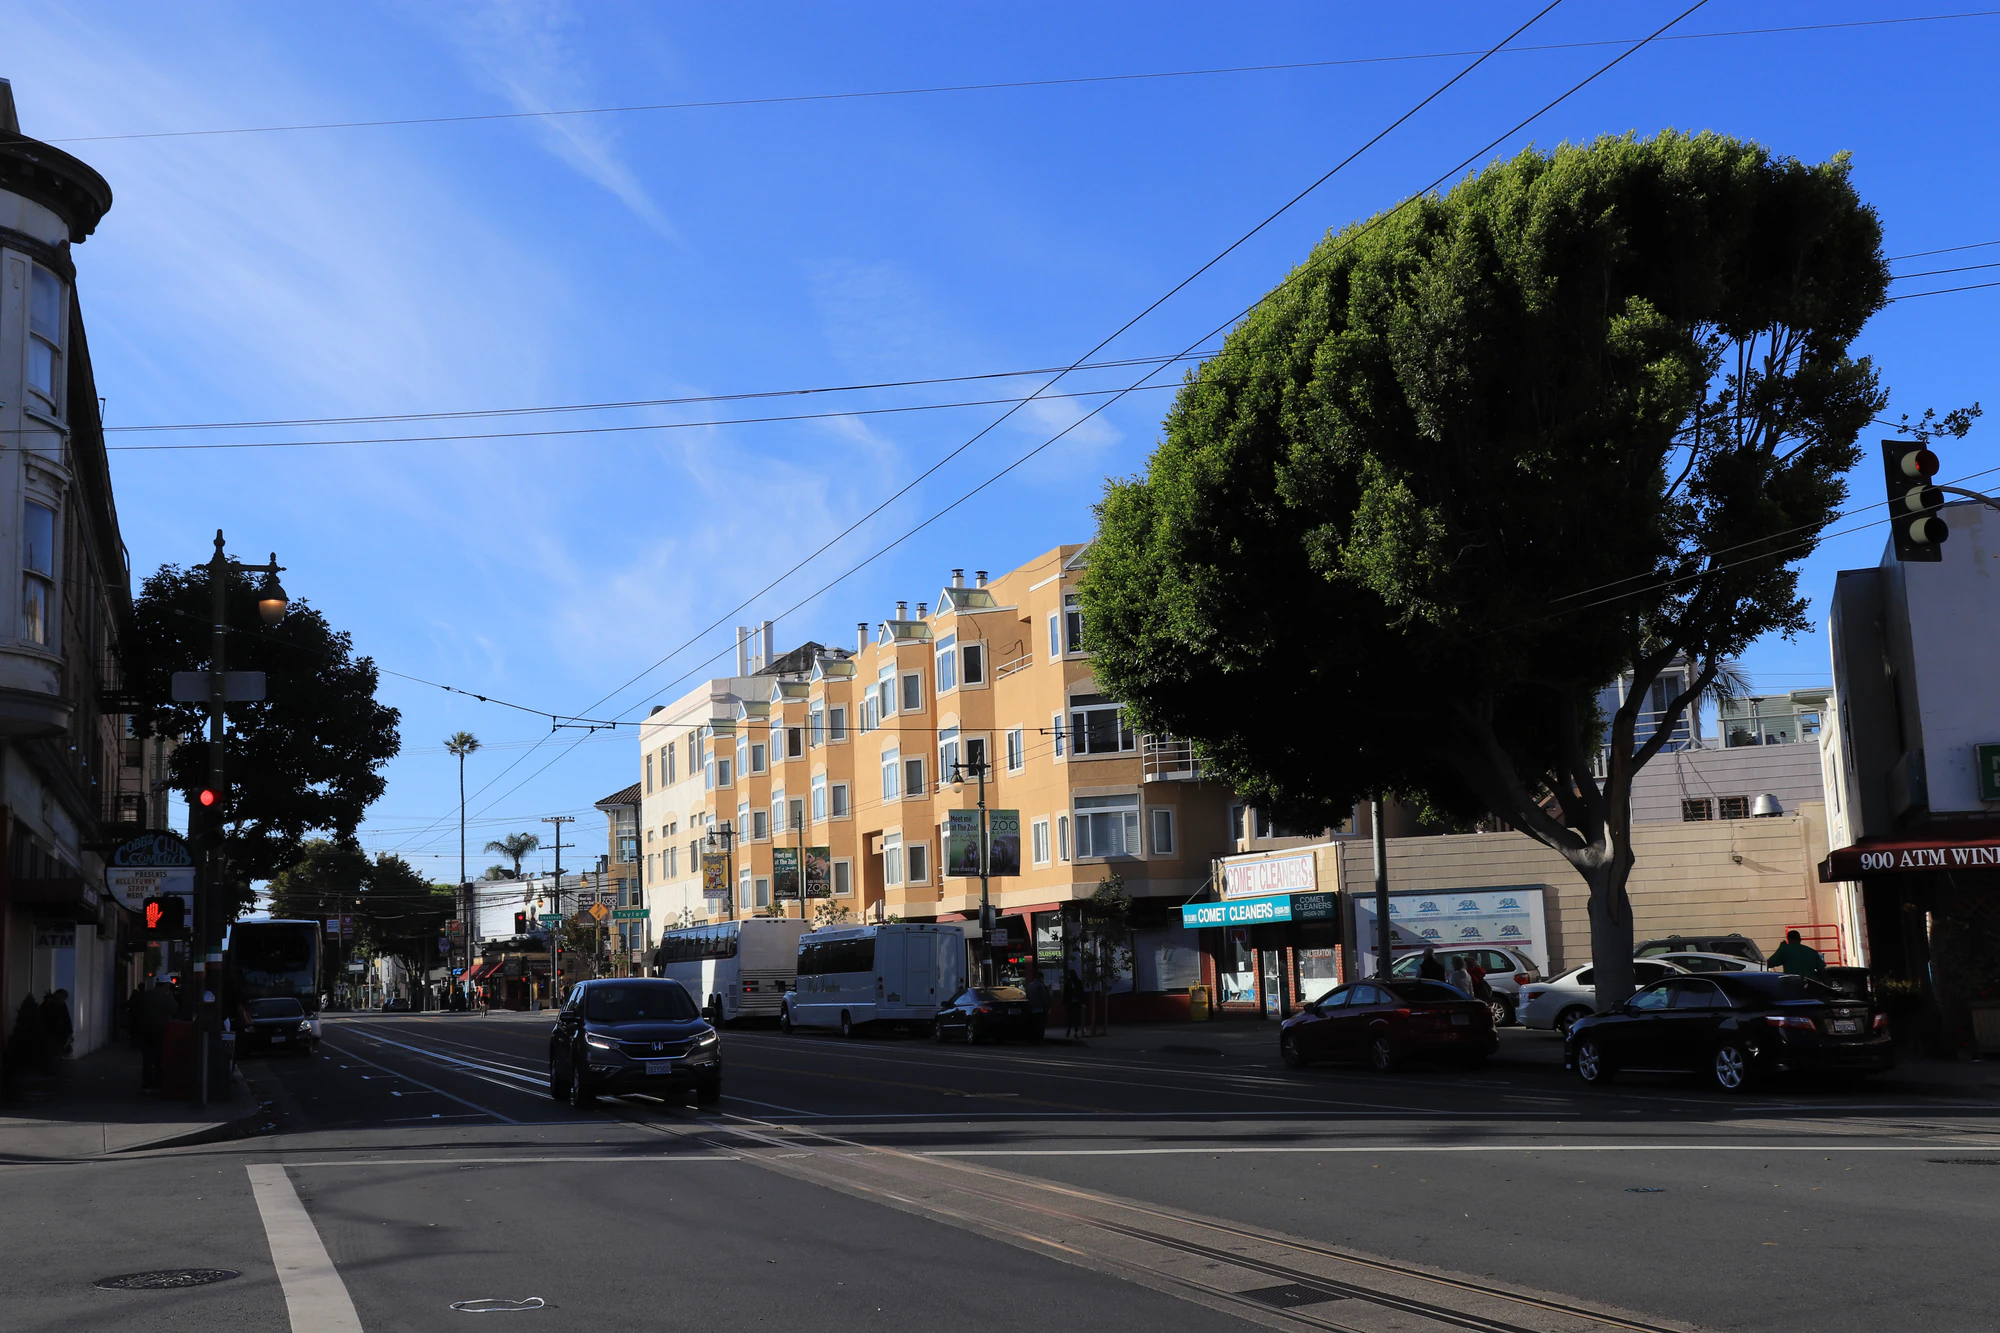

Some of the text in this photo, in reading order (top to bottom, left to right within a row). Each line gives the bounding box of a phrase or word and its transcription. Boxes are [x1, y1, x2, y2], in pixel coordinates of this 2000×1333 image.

[991, 820, 1019, 831] ZOO
[153, 835, 192, 866] CLUB
[129, 852, 179, 865] COMEDY
[1860, 851, 1895, 871] 900
[1899, 849, 1948, 868] ATM
[1227, 865, 1256, 894] COMET
[1259, 858, 1309, 890] CLEANERS
[807, 883, 829, 892] ZOO
[1299, 895, 1325, 904] COMET
[1294, 901, 1332, 911] CLEANERS
[1197, 907, 1226, 923] COMET
[1229, 902, 1273, 921] CLEANERS
[36, 934, 74, 946] ATM
